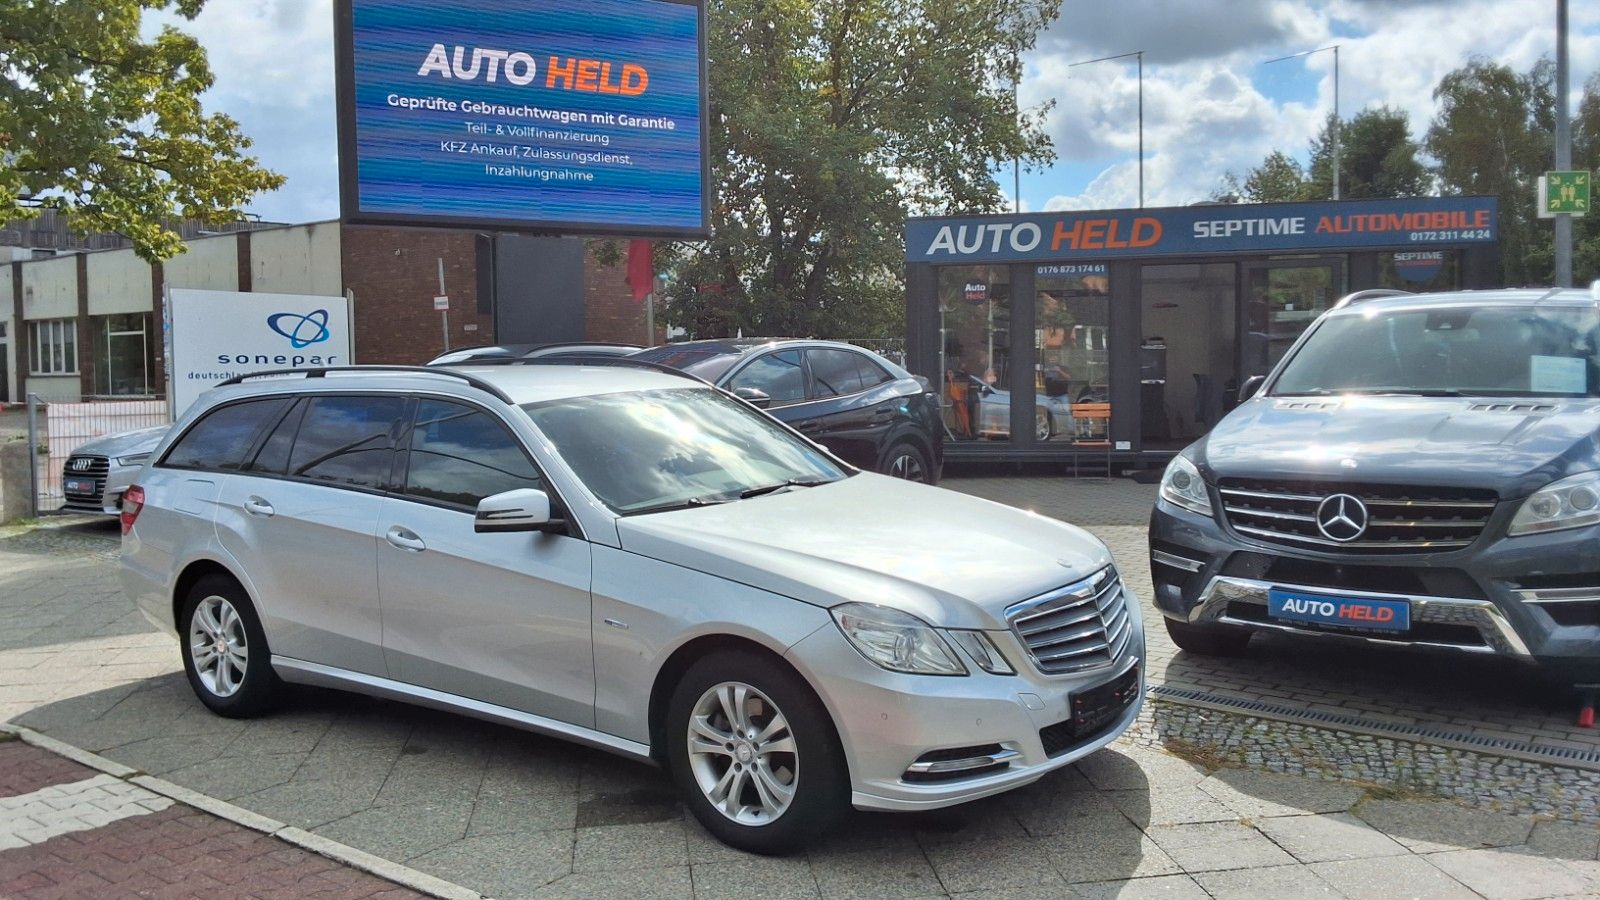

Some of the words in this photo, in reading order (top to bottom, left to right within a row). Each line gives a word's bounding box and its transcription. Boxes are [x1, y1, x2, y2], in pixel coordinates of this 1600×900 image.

[417, 43, 536, 86] AUTO
[545, 55, 649, 97] HELD
[387, 93, 457, 112] Geprüfte
[461, 100, 587, 124] Gebrauchtwagen
[591, 112, 615, 125] mit
[618, 114, 675, 130] Garantie
[465, 121, 492, 134] Teil-
[495, 124, 505, 136] &
[507, 125, 610, 146] Vollfinanzierung
[440, 140, 467, 154] KFZ
[470, 143, 520, 159] Ankauf,
[485, 163, 594, 182] Inzahlungnahme
[1193, 217, 1305, 238] SEPTIME
[1315, 210, 1490, 234] AUTOMOBILE
[925, 222, 1042, 256] AUTO
[1051, 217, 1163, 250] HELD
[1410, 231, 1437, 241] 0172
[1439, 231, 1458, 240] 311
[1460, 230, 1475, 239] 44
[1476, 229, 1491, 239] 24
[1393, 251, 1443, 261] SEPTIME
[1037, 266, 1058, 274] 0176
[1059, 266, 1076, 274] 873
[1095, 264, 1105, 272] 61
[965, 283, 986, 292] Auto
[965, 292, 986, 300] Held
[218, 354, 337, 367] sonepar
[1281, 598, 1335, 617] AUTO
[1339, 604, 1394, 622] HELD
